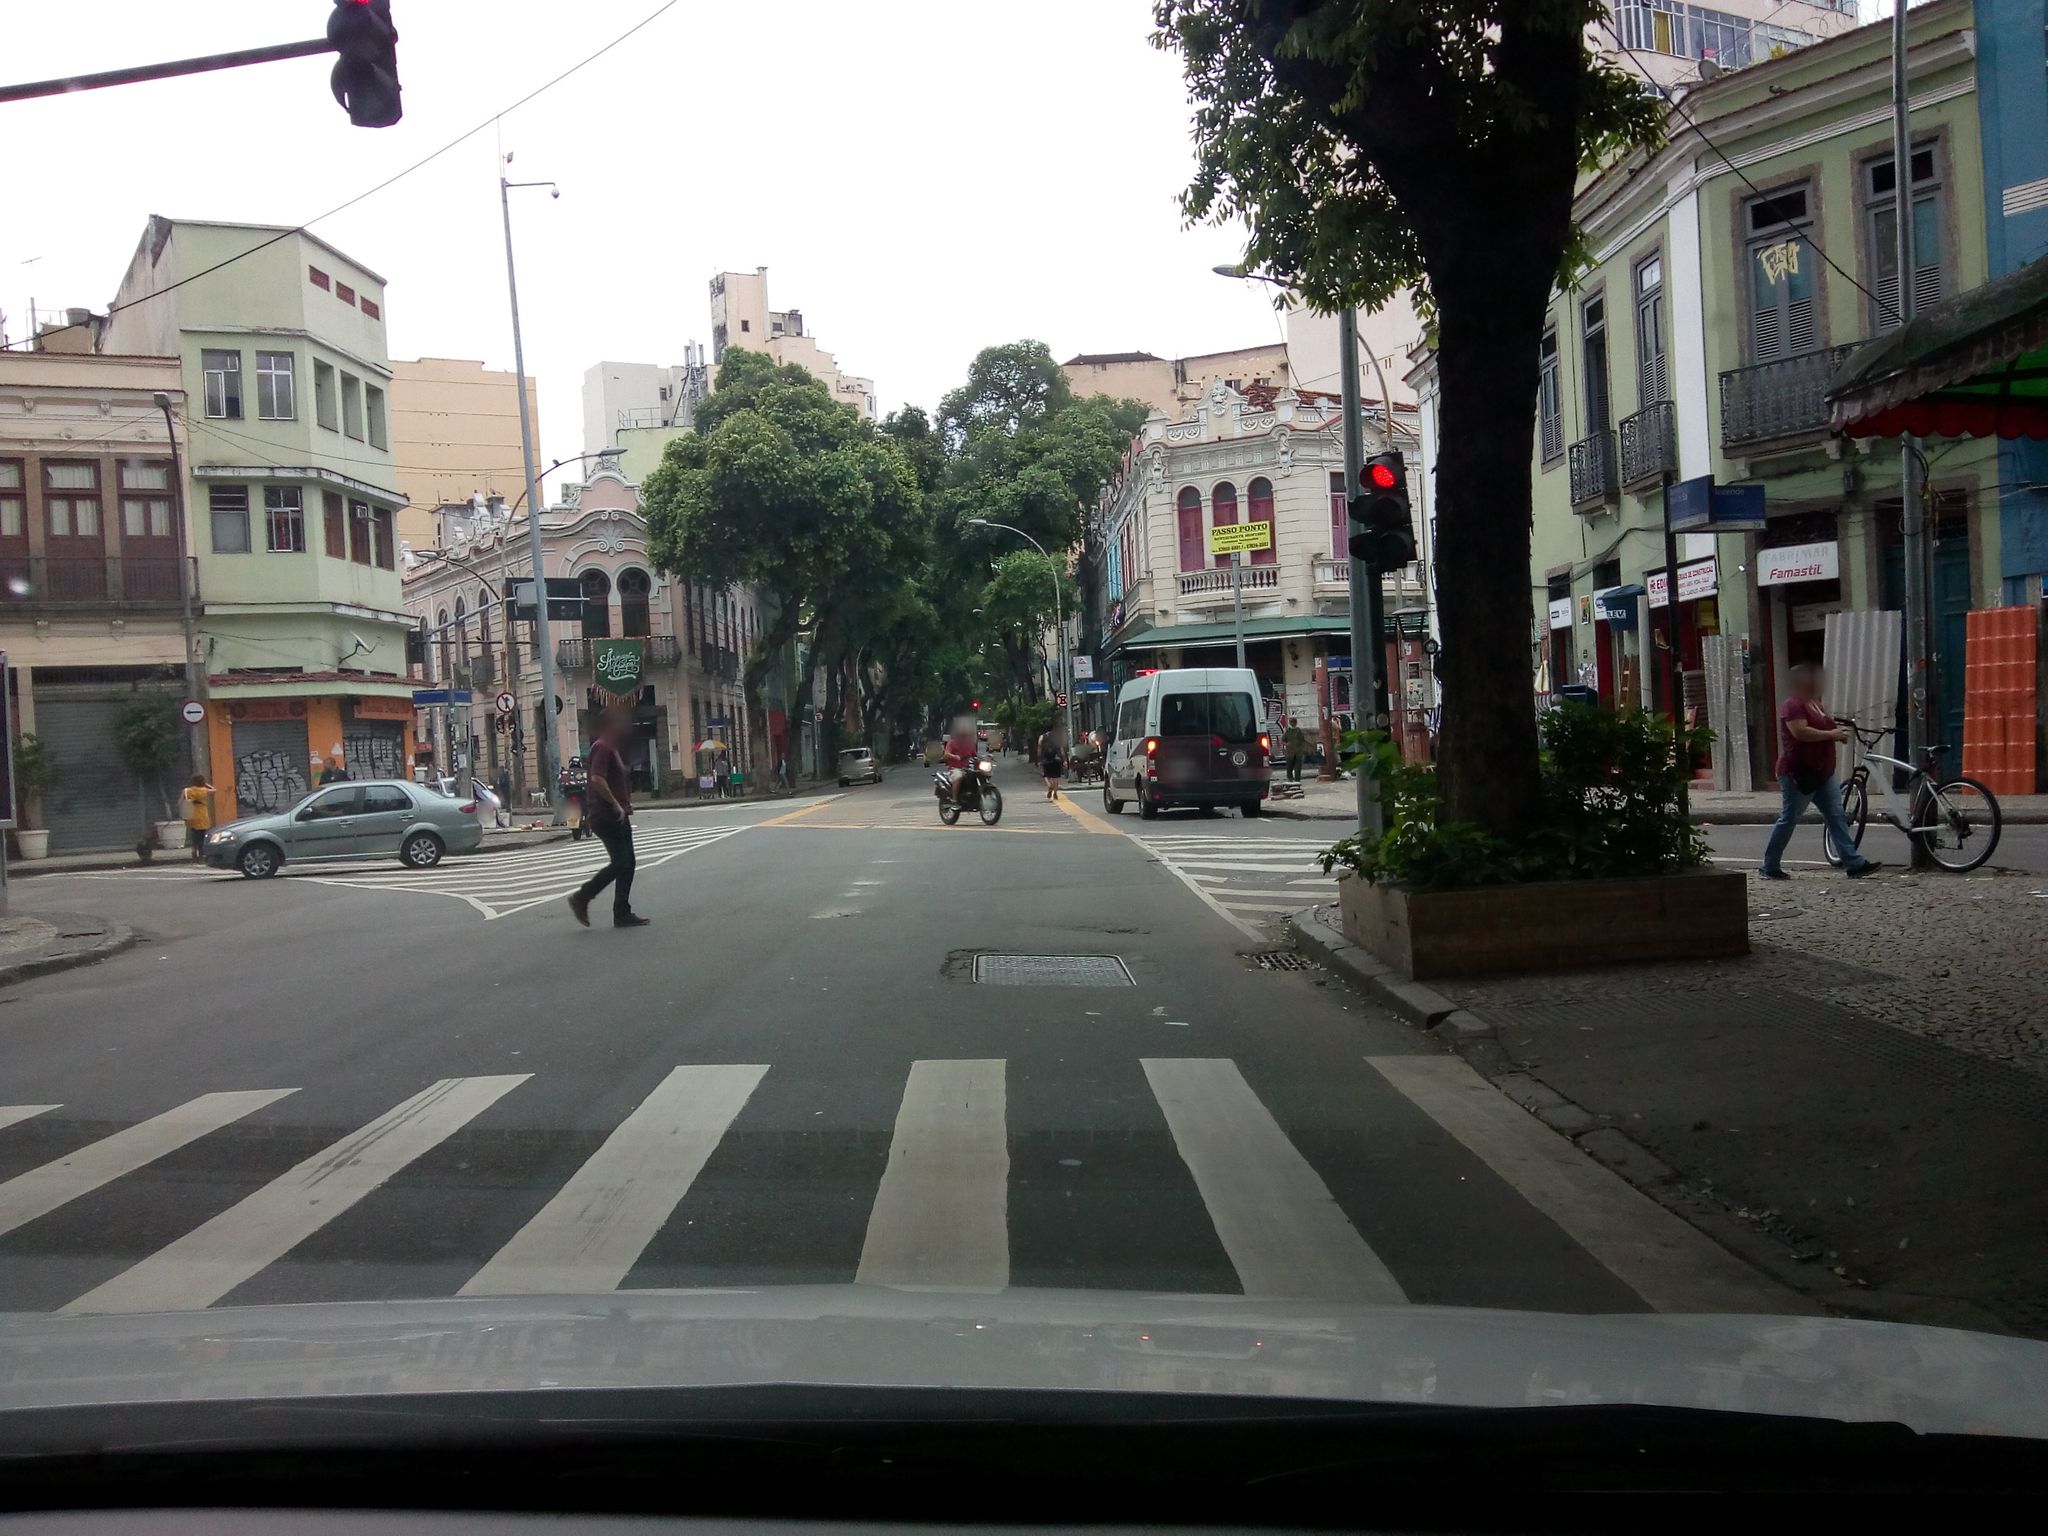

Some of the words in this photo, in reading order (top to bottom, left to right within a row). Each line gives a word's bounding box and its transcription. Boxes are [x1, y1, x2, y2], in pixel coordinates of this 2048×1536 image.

[1212, 527, 1237, 536] PASSO
[1240, 523, 1268, 532] PONTO
[1769, 564, 1823, 581] Famastil
